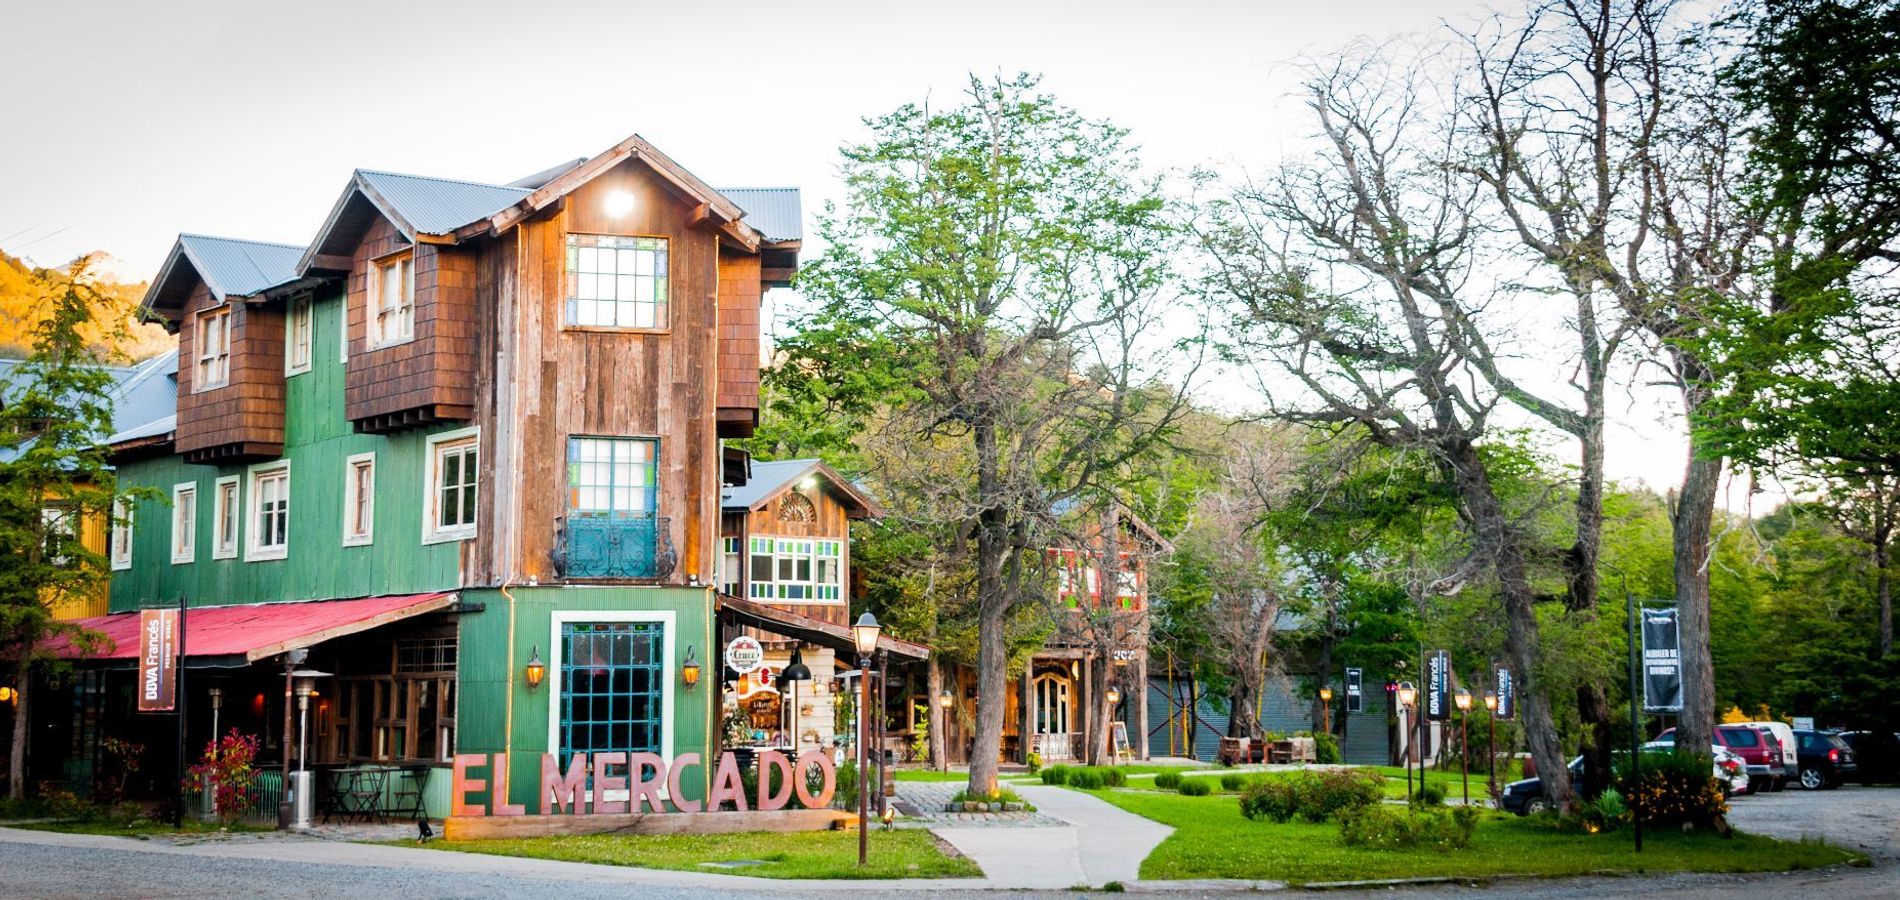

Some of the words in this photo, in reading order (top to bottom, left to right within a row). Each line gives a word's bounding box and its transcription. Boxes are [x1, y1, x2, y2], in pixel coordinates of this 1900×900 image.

[147, 619, 159, 665] Francés
[146, 667, 158, 699] BBVA
[1429, 657, 1439, 690] Francés
[1430, 691, 1439, 715] BBVA
[452, 753, 525, 816] EL
[540, 751, 837, 815] MERCADO
